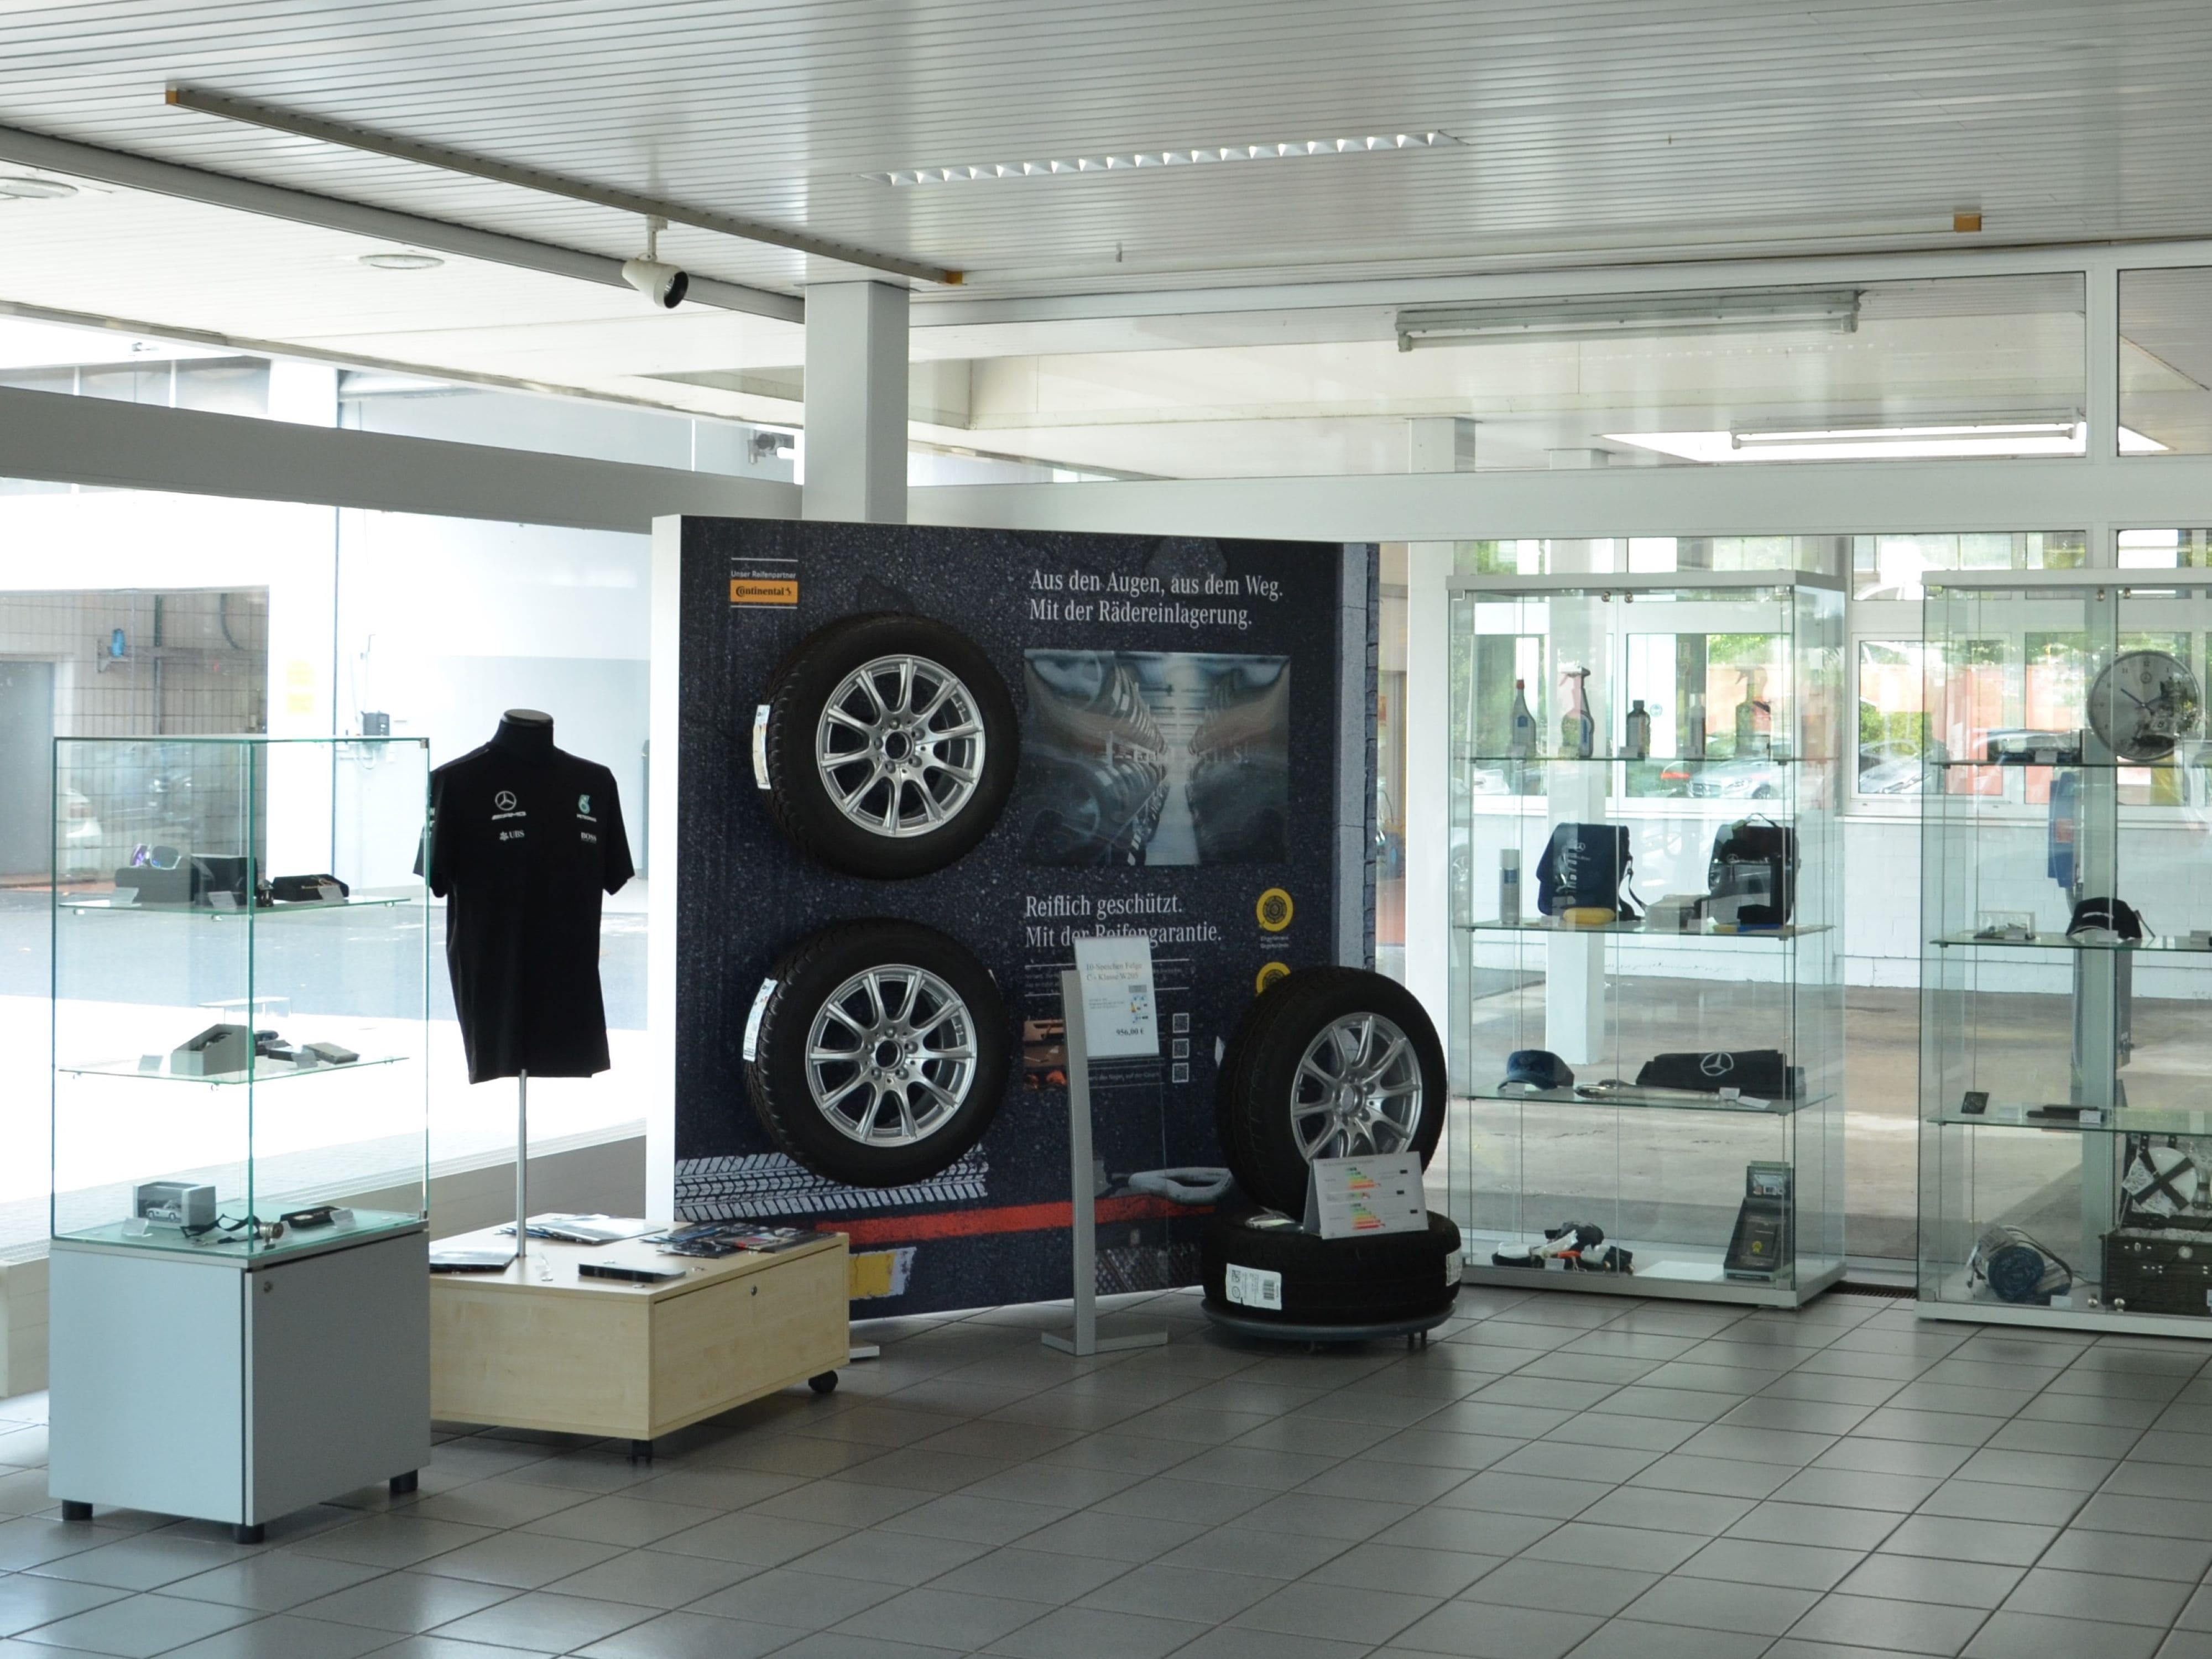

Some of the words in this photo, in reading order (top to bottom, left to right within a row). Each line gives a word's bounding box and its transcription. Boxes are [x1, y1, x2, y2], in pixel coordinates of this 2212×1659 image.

[752, 570, 796, 579] Reifenpartner
[1030, 568, 1063, 591] Aus
[1069, 570, 1100, 591] den
[1106, 571, 1165, 597] Augen,
[1171, 577, 1199, 594] aus
[1205, 573, 1239, 595] dem
[1245, 575, 1283, 601] Weg.
[735, 586, 785, 597] Continental
[1029, 599, 1059, 620] Mit
[1065, 600, 1093, 621] der
[1099, 600, 1252, 629] Rädereinlagerung.
[509, 830, 525, 839] UBS
[1025, 895, 1091, 917] Reiflich
[1097, 893, 1183, 920] geschützt.
[1025, 926, 1055, 947] Mit
